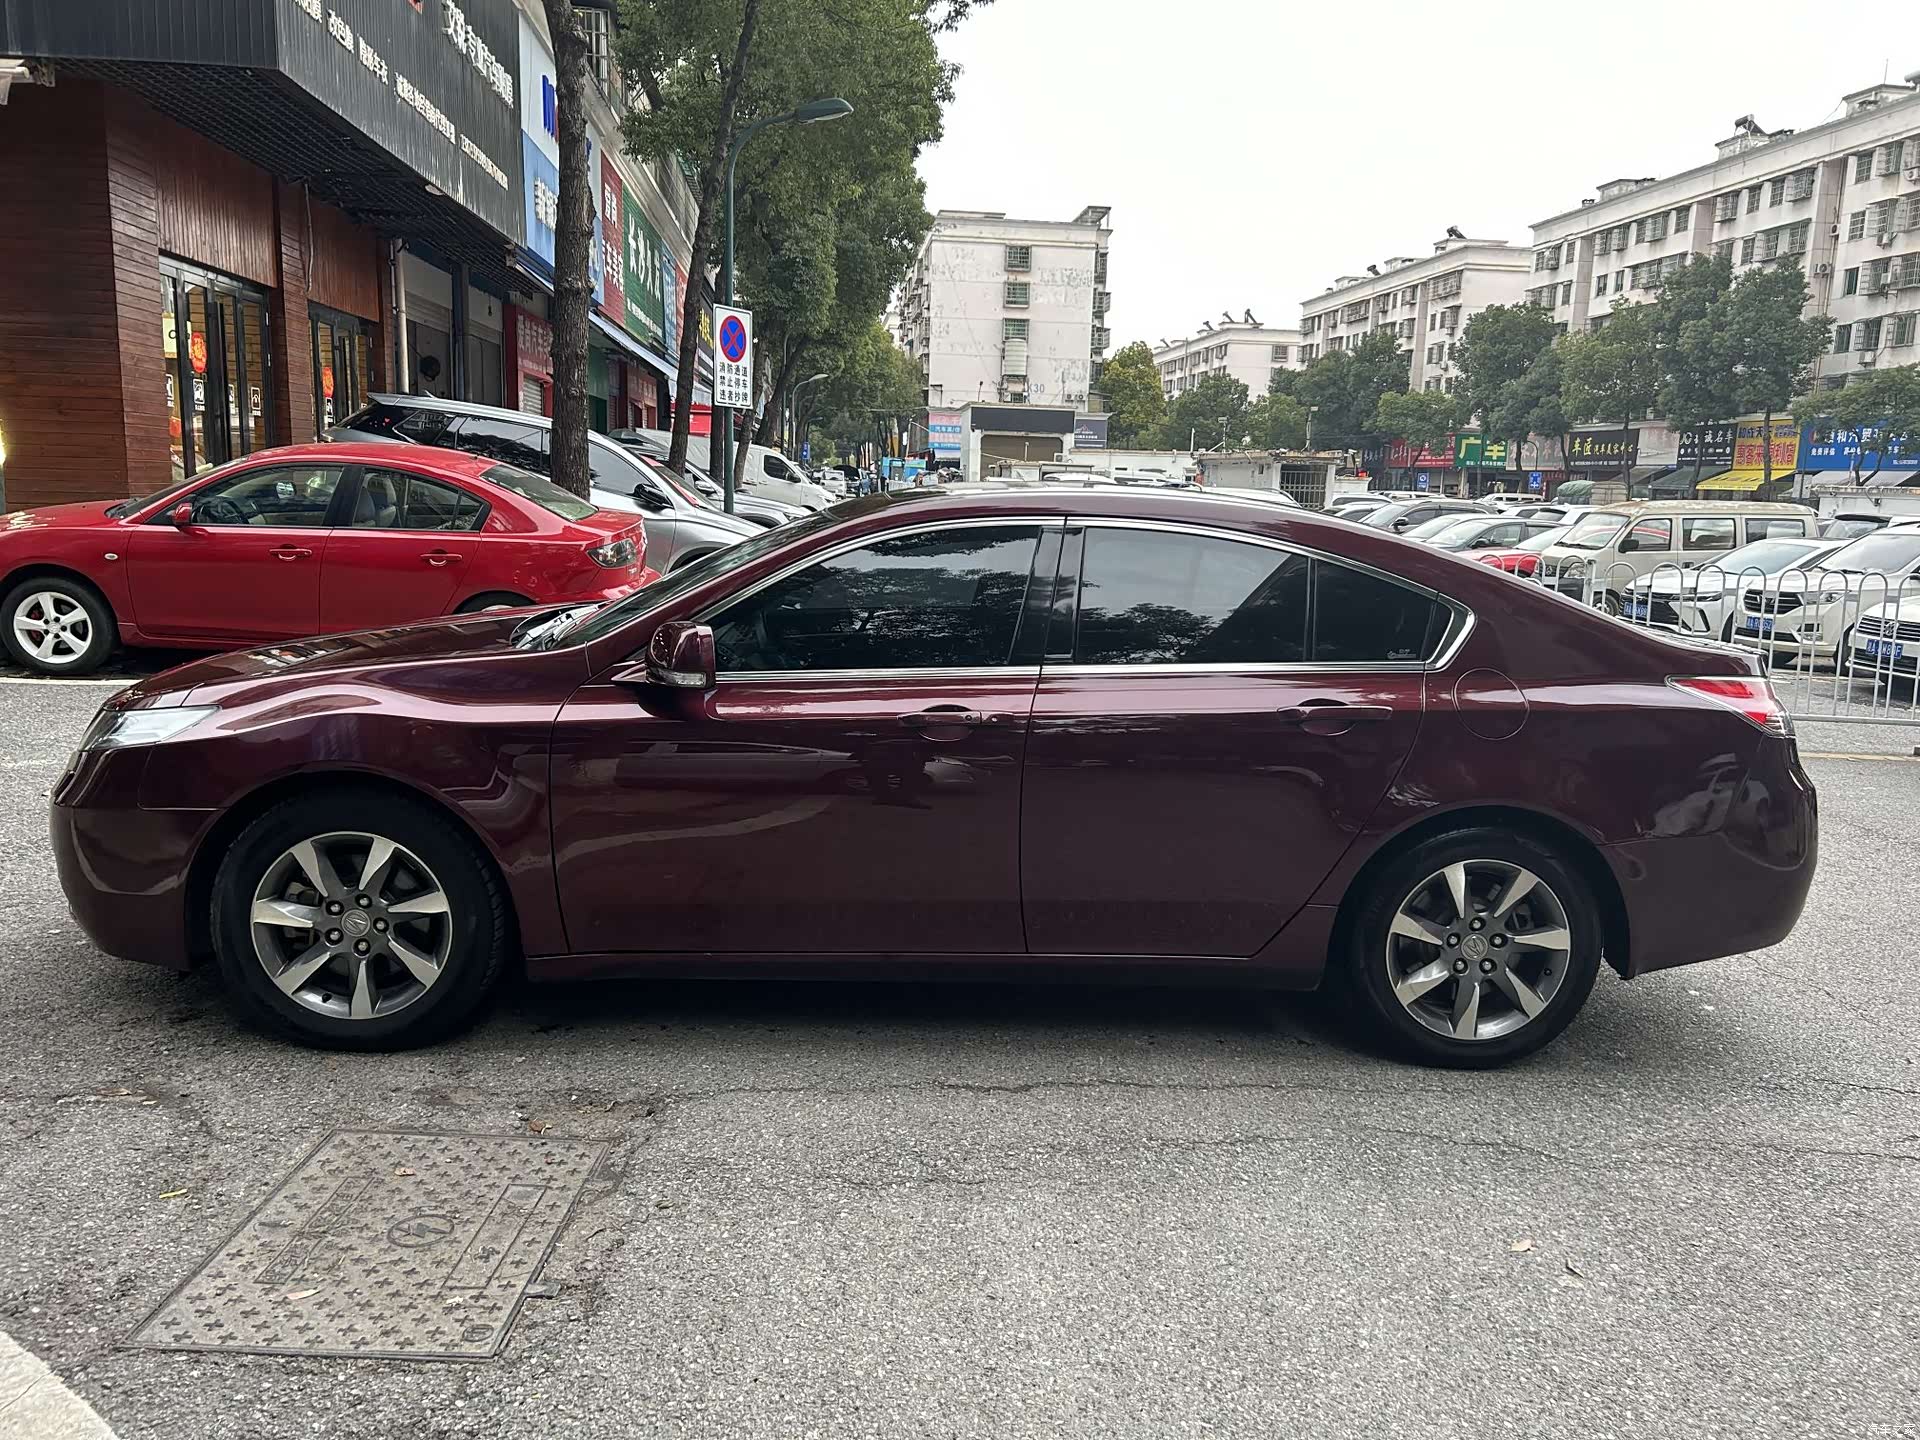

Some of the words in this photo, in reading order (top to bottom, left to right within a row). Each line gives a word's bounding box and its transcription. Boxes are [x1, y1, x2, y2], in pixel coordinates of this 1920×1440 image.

[718, 361, 748, 378] 消防通道
[719, 375, 748, 390] 禁止停车
[719, 388, 749, 403] 违者抄牌
